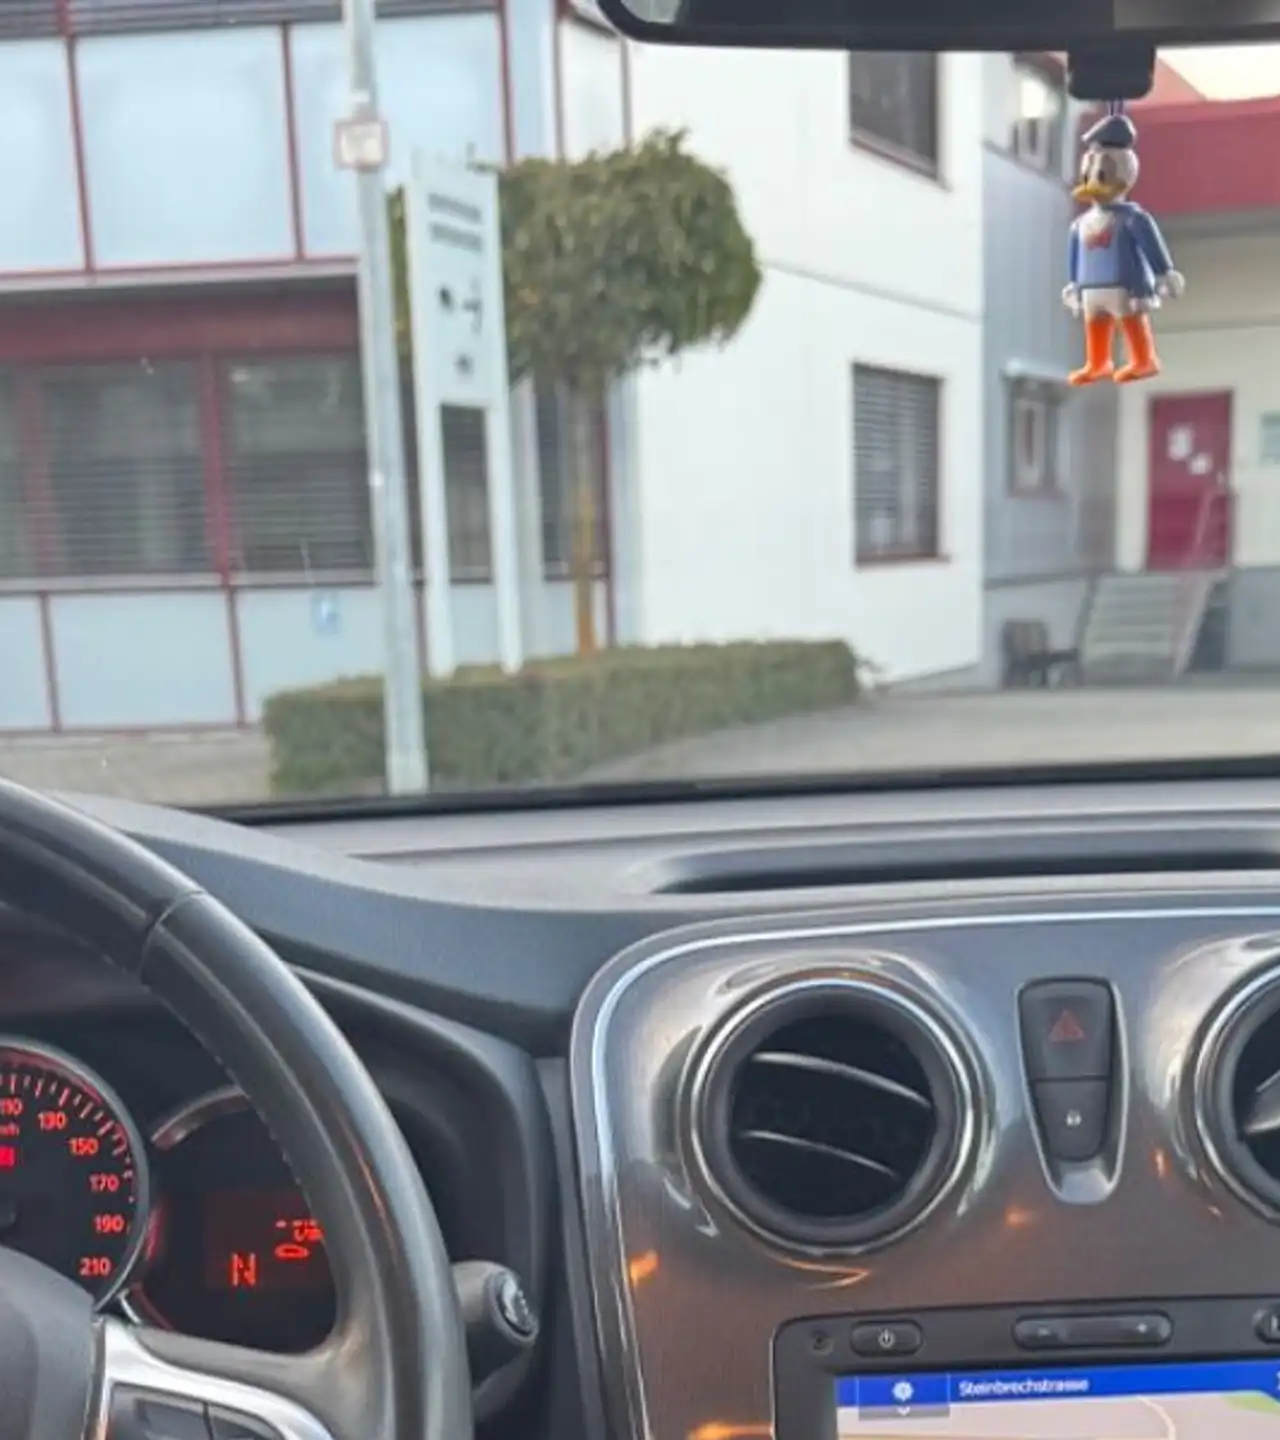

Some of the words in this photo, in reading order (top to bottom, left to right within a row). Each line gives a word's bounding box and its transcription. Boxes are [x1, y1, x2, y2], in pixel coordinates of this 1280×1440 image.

[38, 1112, 67, 1130] 130
[70, 1137, 99, 1156] 150
[89, 1174, 119, 1192] 170
[93, 1214, 125, 1233] 190
[79, 1257, 112, 1276] 210
[231, 1252, 256, 1286] N
